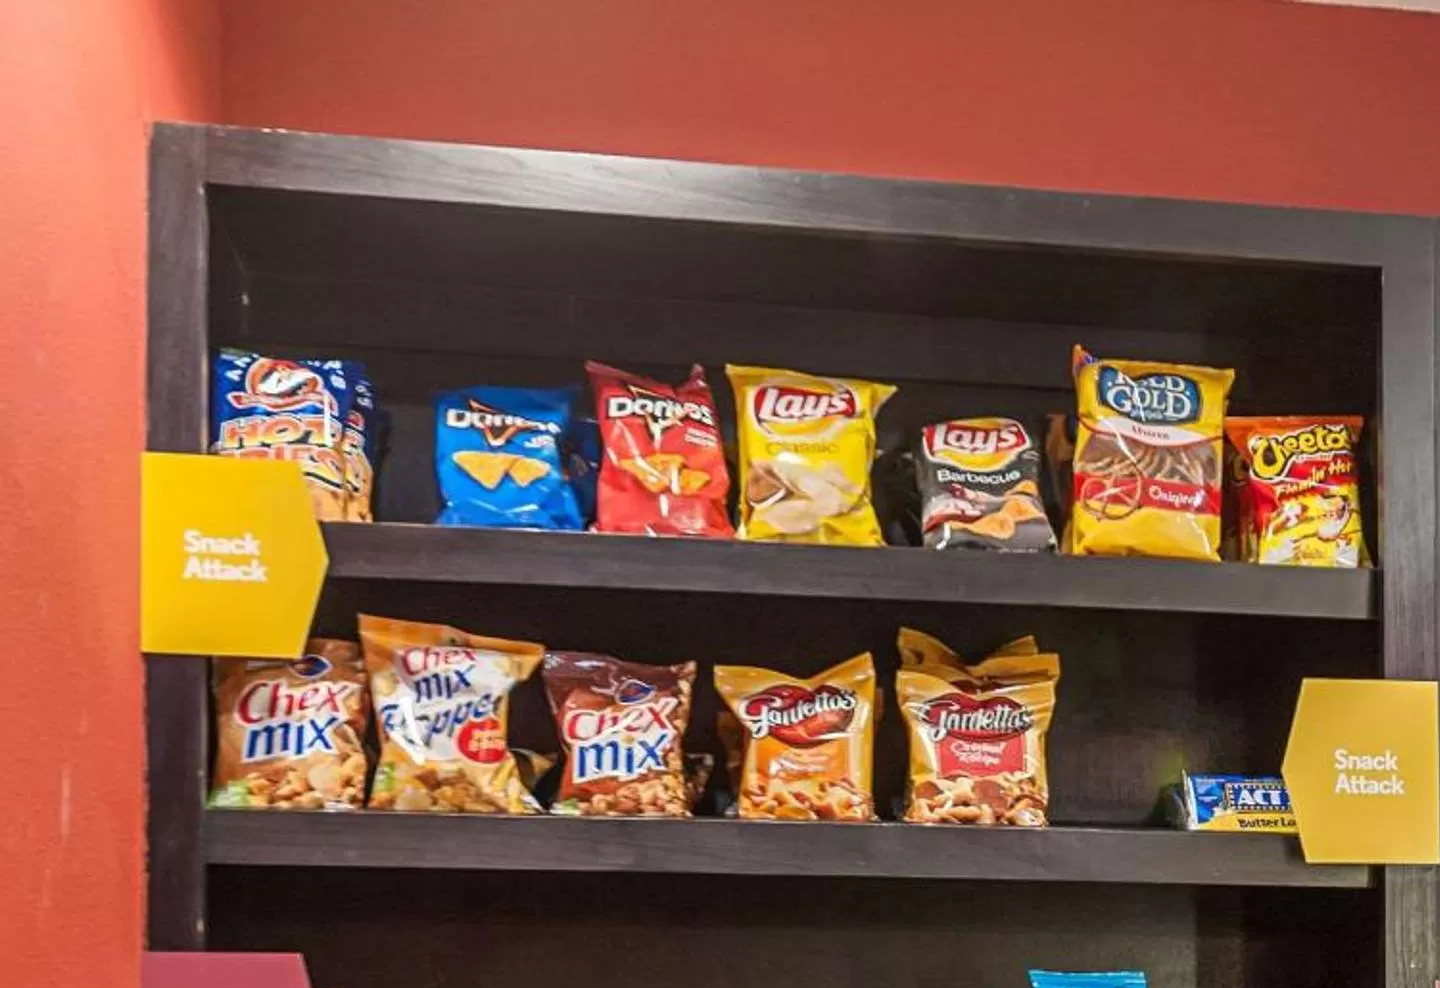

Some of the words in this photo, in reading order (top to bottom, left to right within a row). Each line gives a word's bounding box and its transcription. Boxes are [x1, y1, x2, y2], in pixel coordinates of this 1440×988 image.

[1106, 386, 1193, 422] GOLD
[1252, 425, 1350, 478] Cheeto
[936, 468, 1021, 484] Barbecue
[183, 528, 261, 556] Snack
[182, 555, 268, 582] Attack
[402, 648, 476, 677] Chex
[235, 680, 350, 725] Chex
[567, 699, 676, 741] Chex
[1334, 749, 1398, 771] Snack
[1238, 788, 1281, 806] ACT
[1335, 773, 1405, 795] Attack
[1237, 815, 1279, 829] Butter
